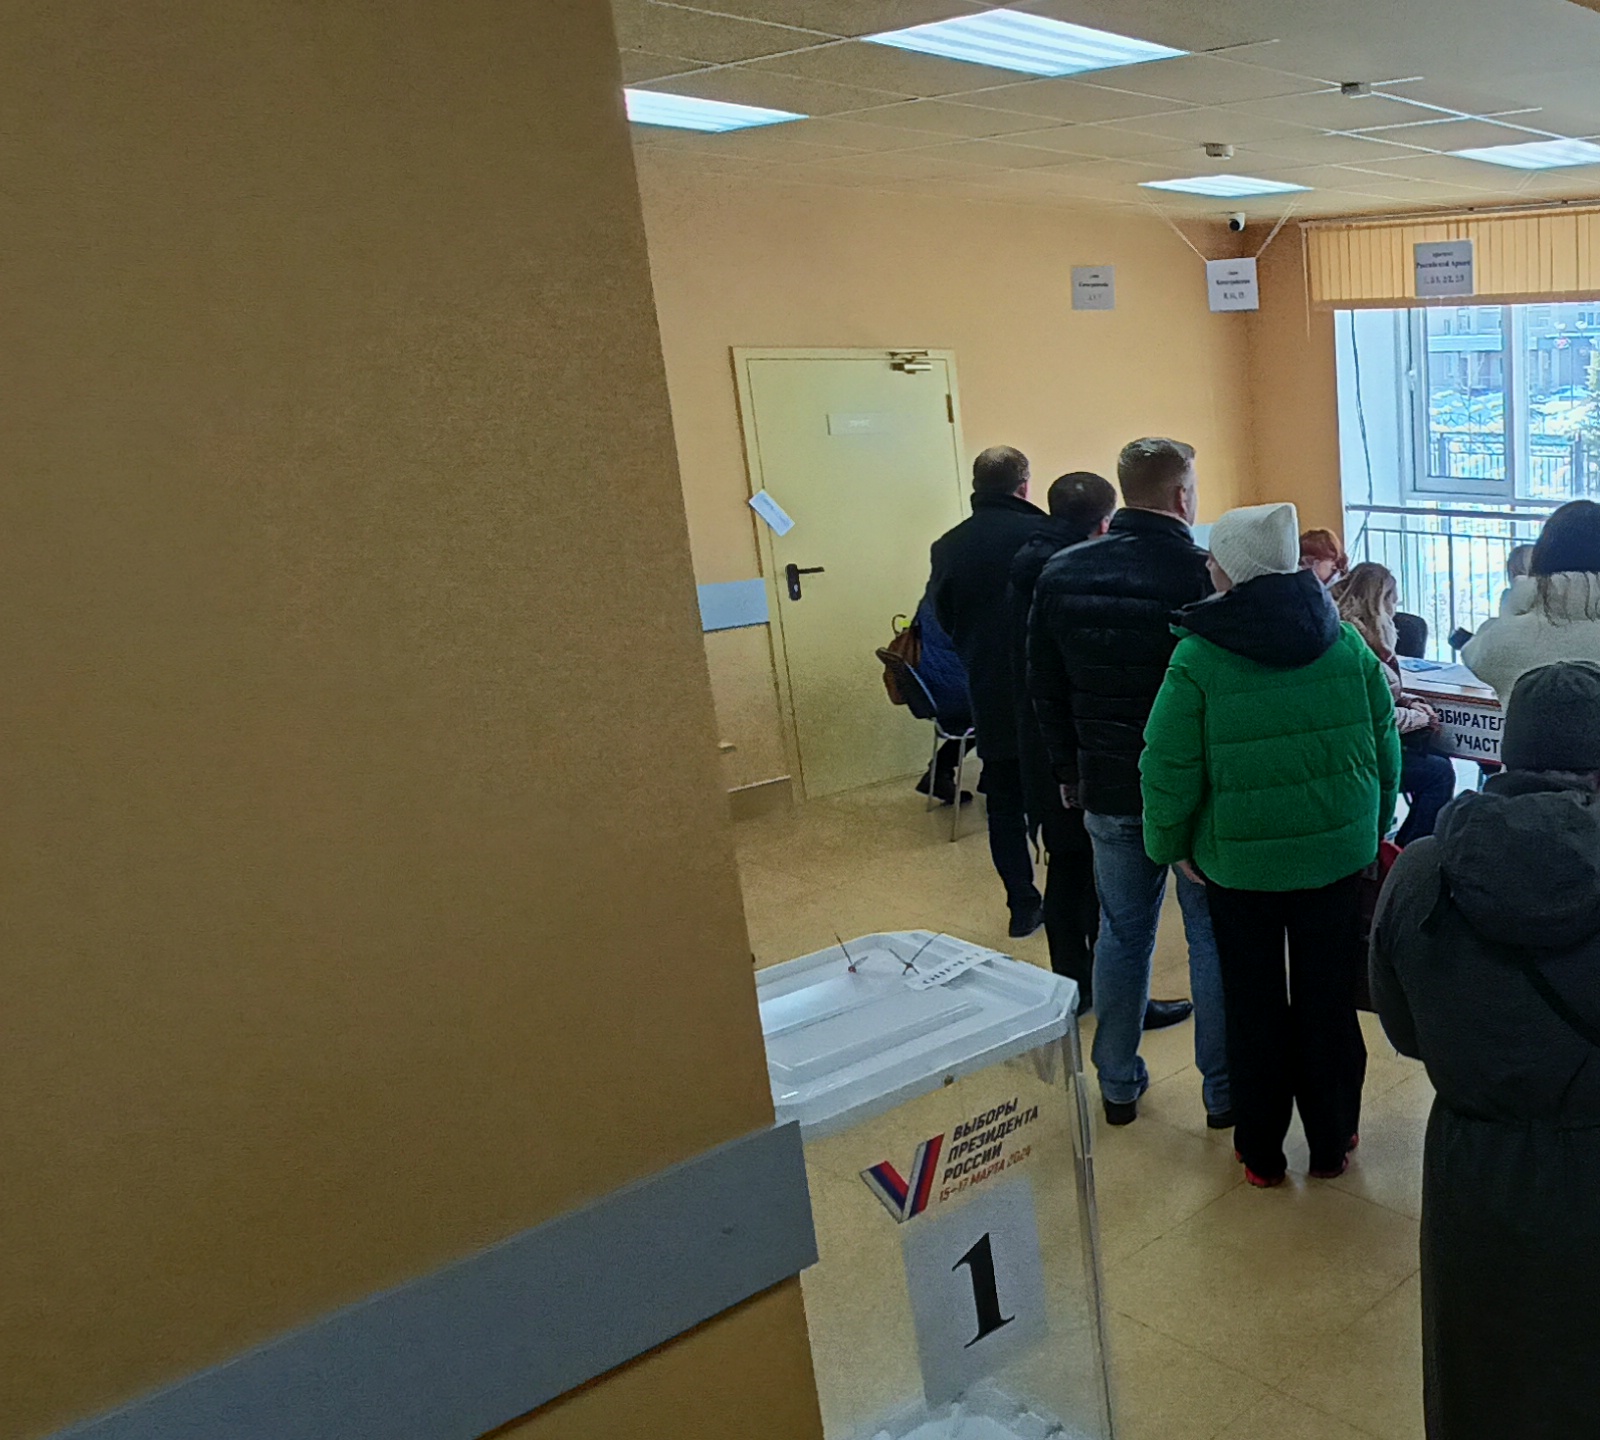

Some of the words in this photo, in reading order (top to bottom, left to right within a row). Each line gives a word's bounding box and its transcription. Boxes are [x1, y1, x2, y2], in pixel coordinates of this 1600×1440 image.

[947, 1105, 1038, 1164] ПРЕЗИДЕНТА
[953, 1097, 1018, 1142] ВЫБОРЫ
[942, 1141, 1003, 1185] РОССИИ
[969, 1158, 1005, 1187] МАРТА
[951, 1231, 1016, 1349] 1
